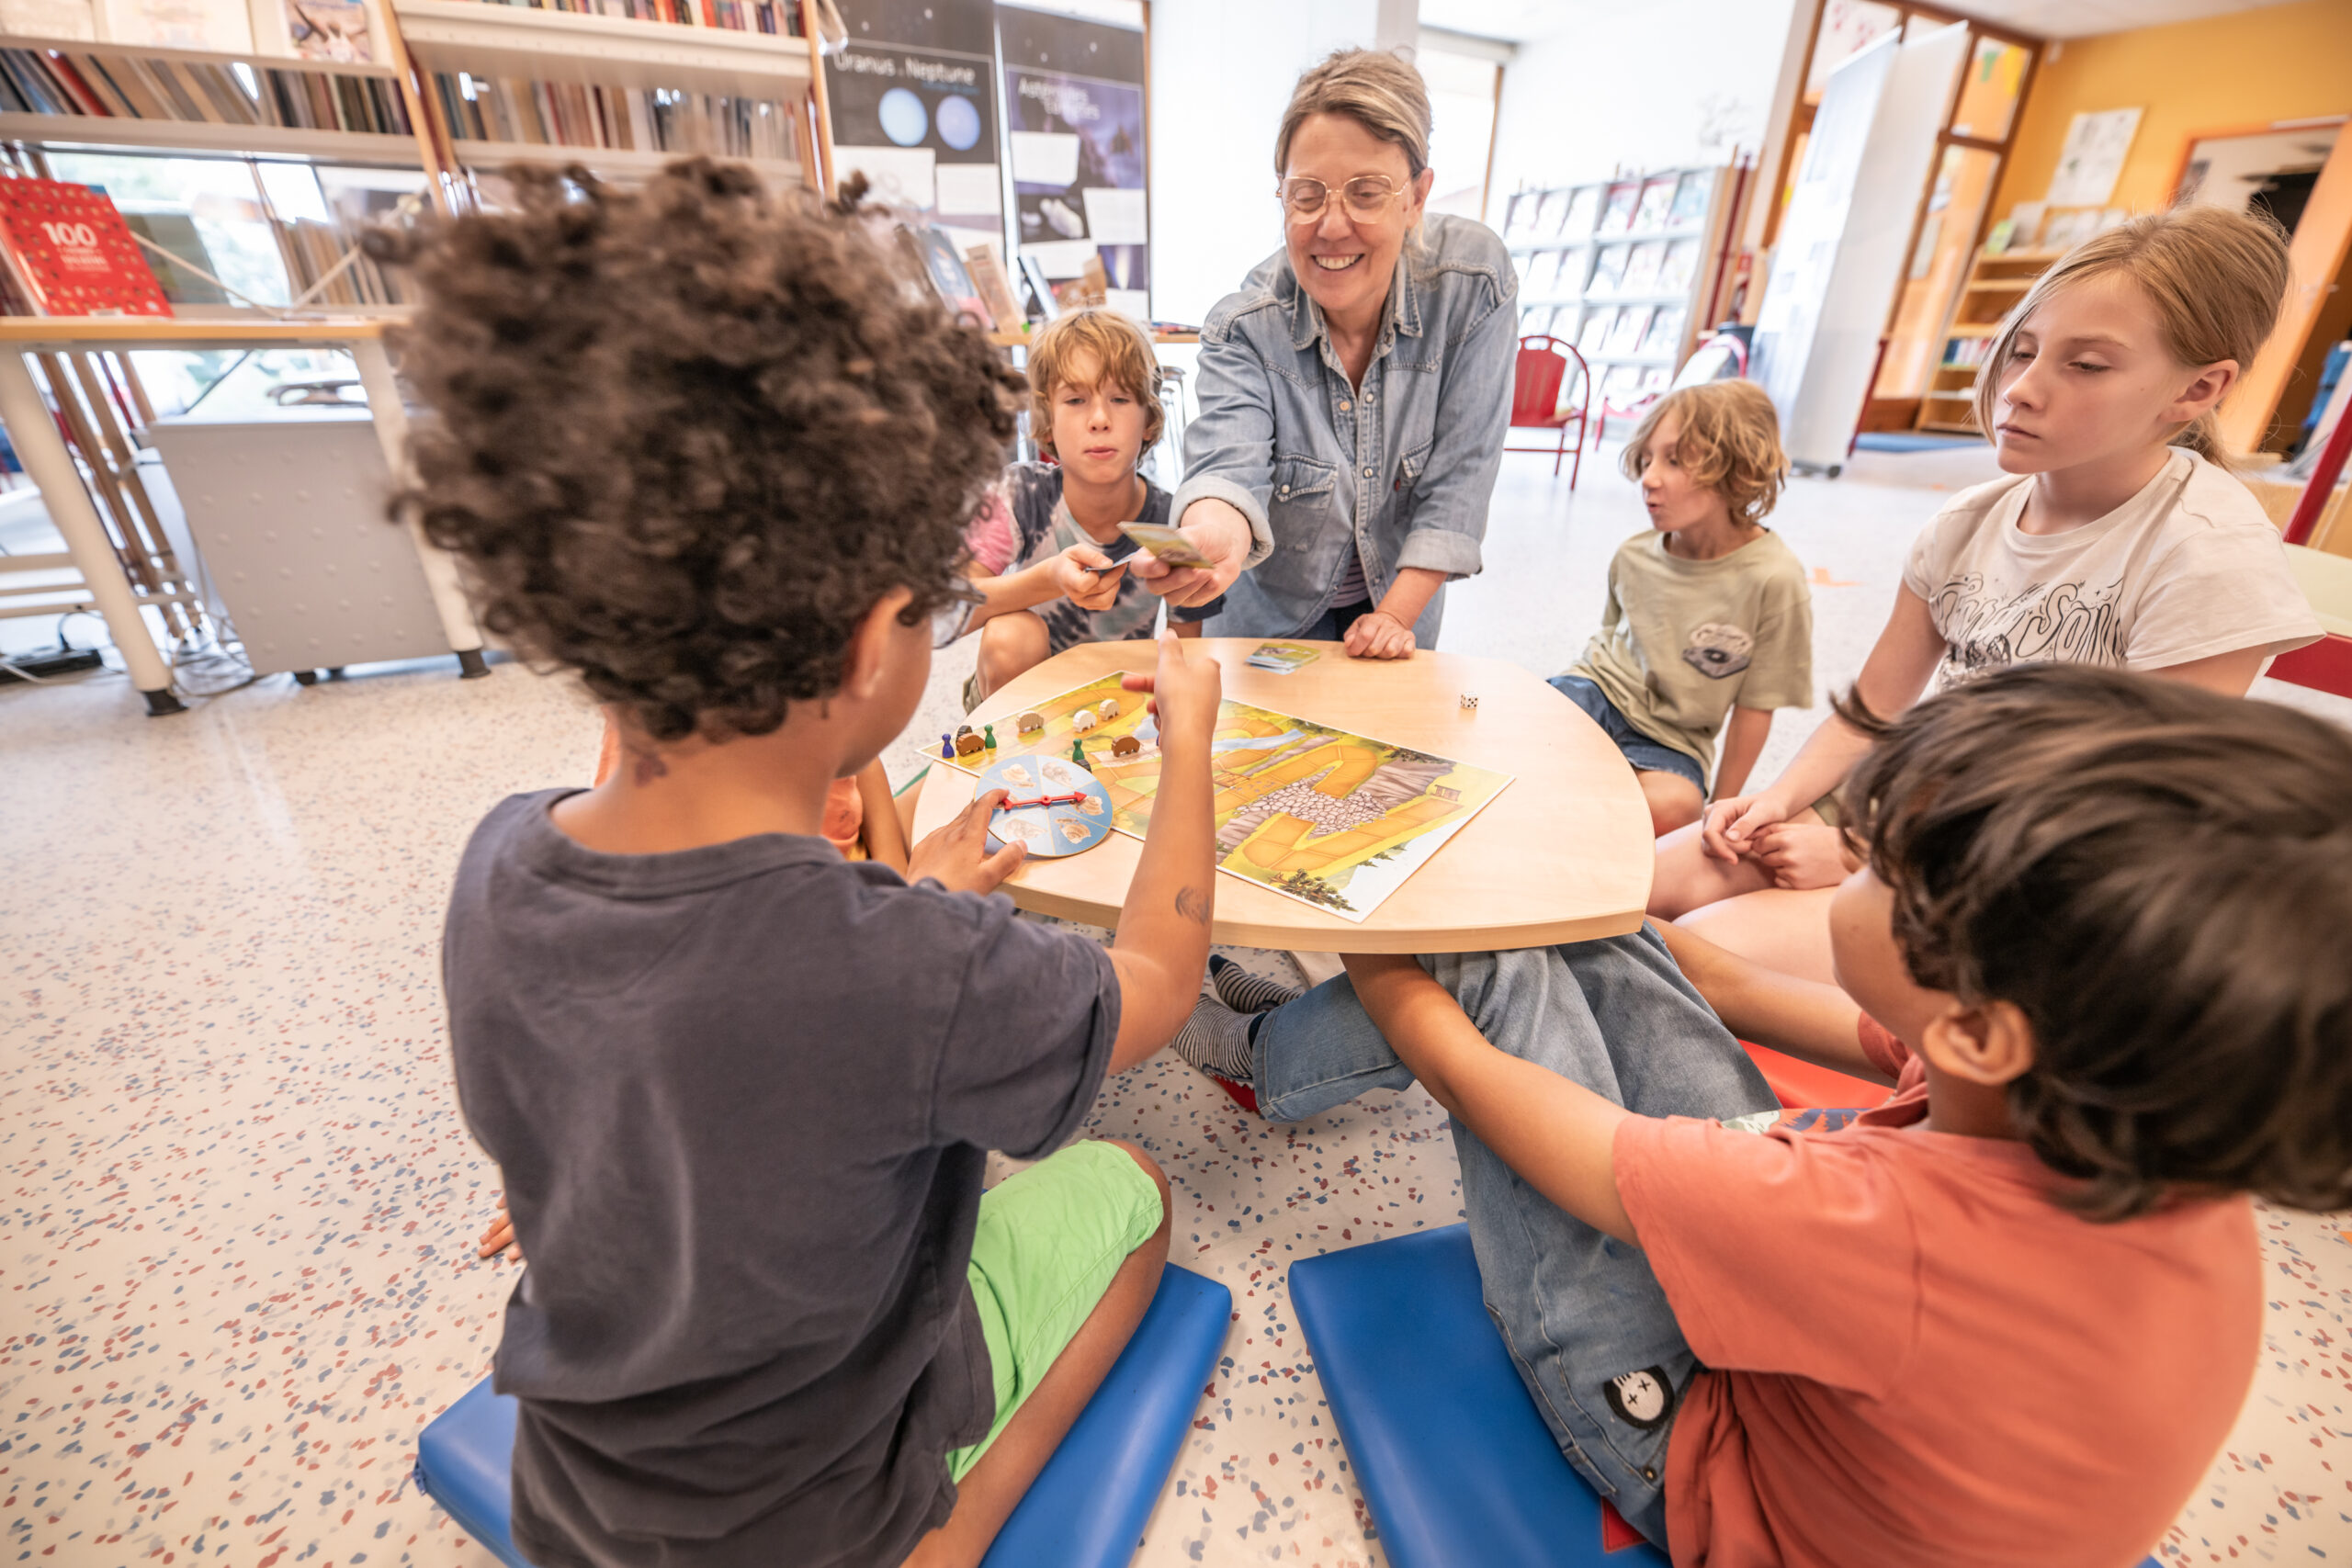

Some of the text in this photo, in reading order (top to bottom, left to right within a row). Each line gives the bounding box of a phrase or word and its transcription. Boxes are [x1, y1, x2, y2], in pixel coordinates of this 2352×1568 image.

[833, 51, 896, 77] Uranus
[905, 56, 976, 85] Neptune
[40, 221, 97, 246] 100
